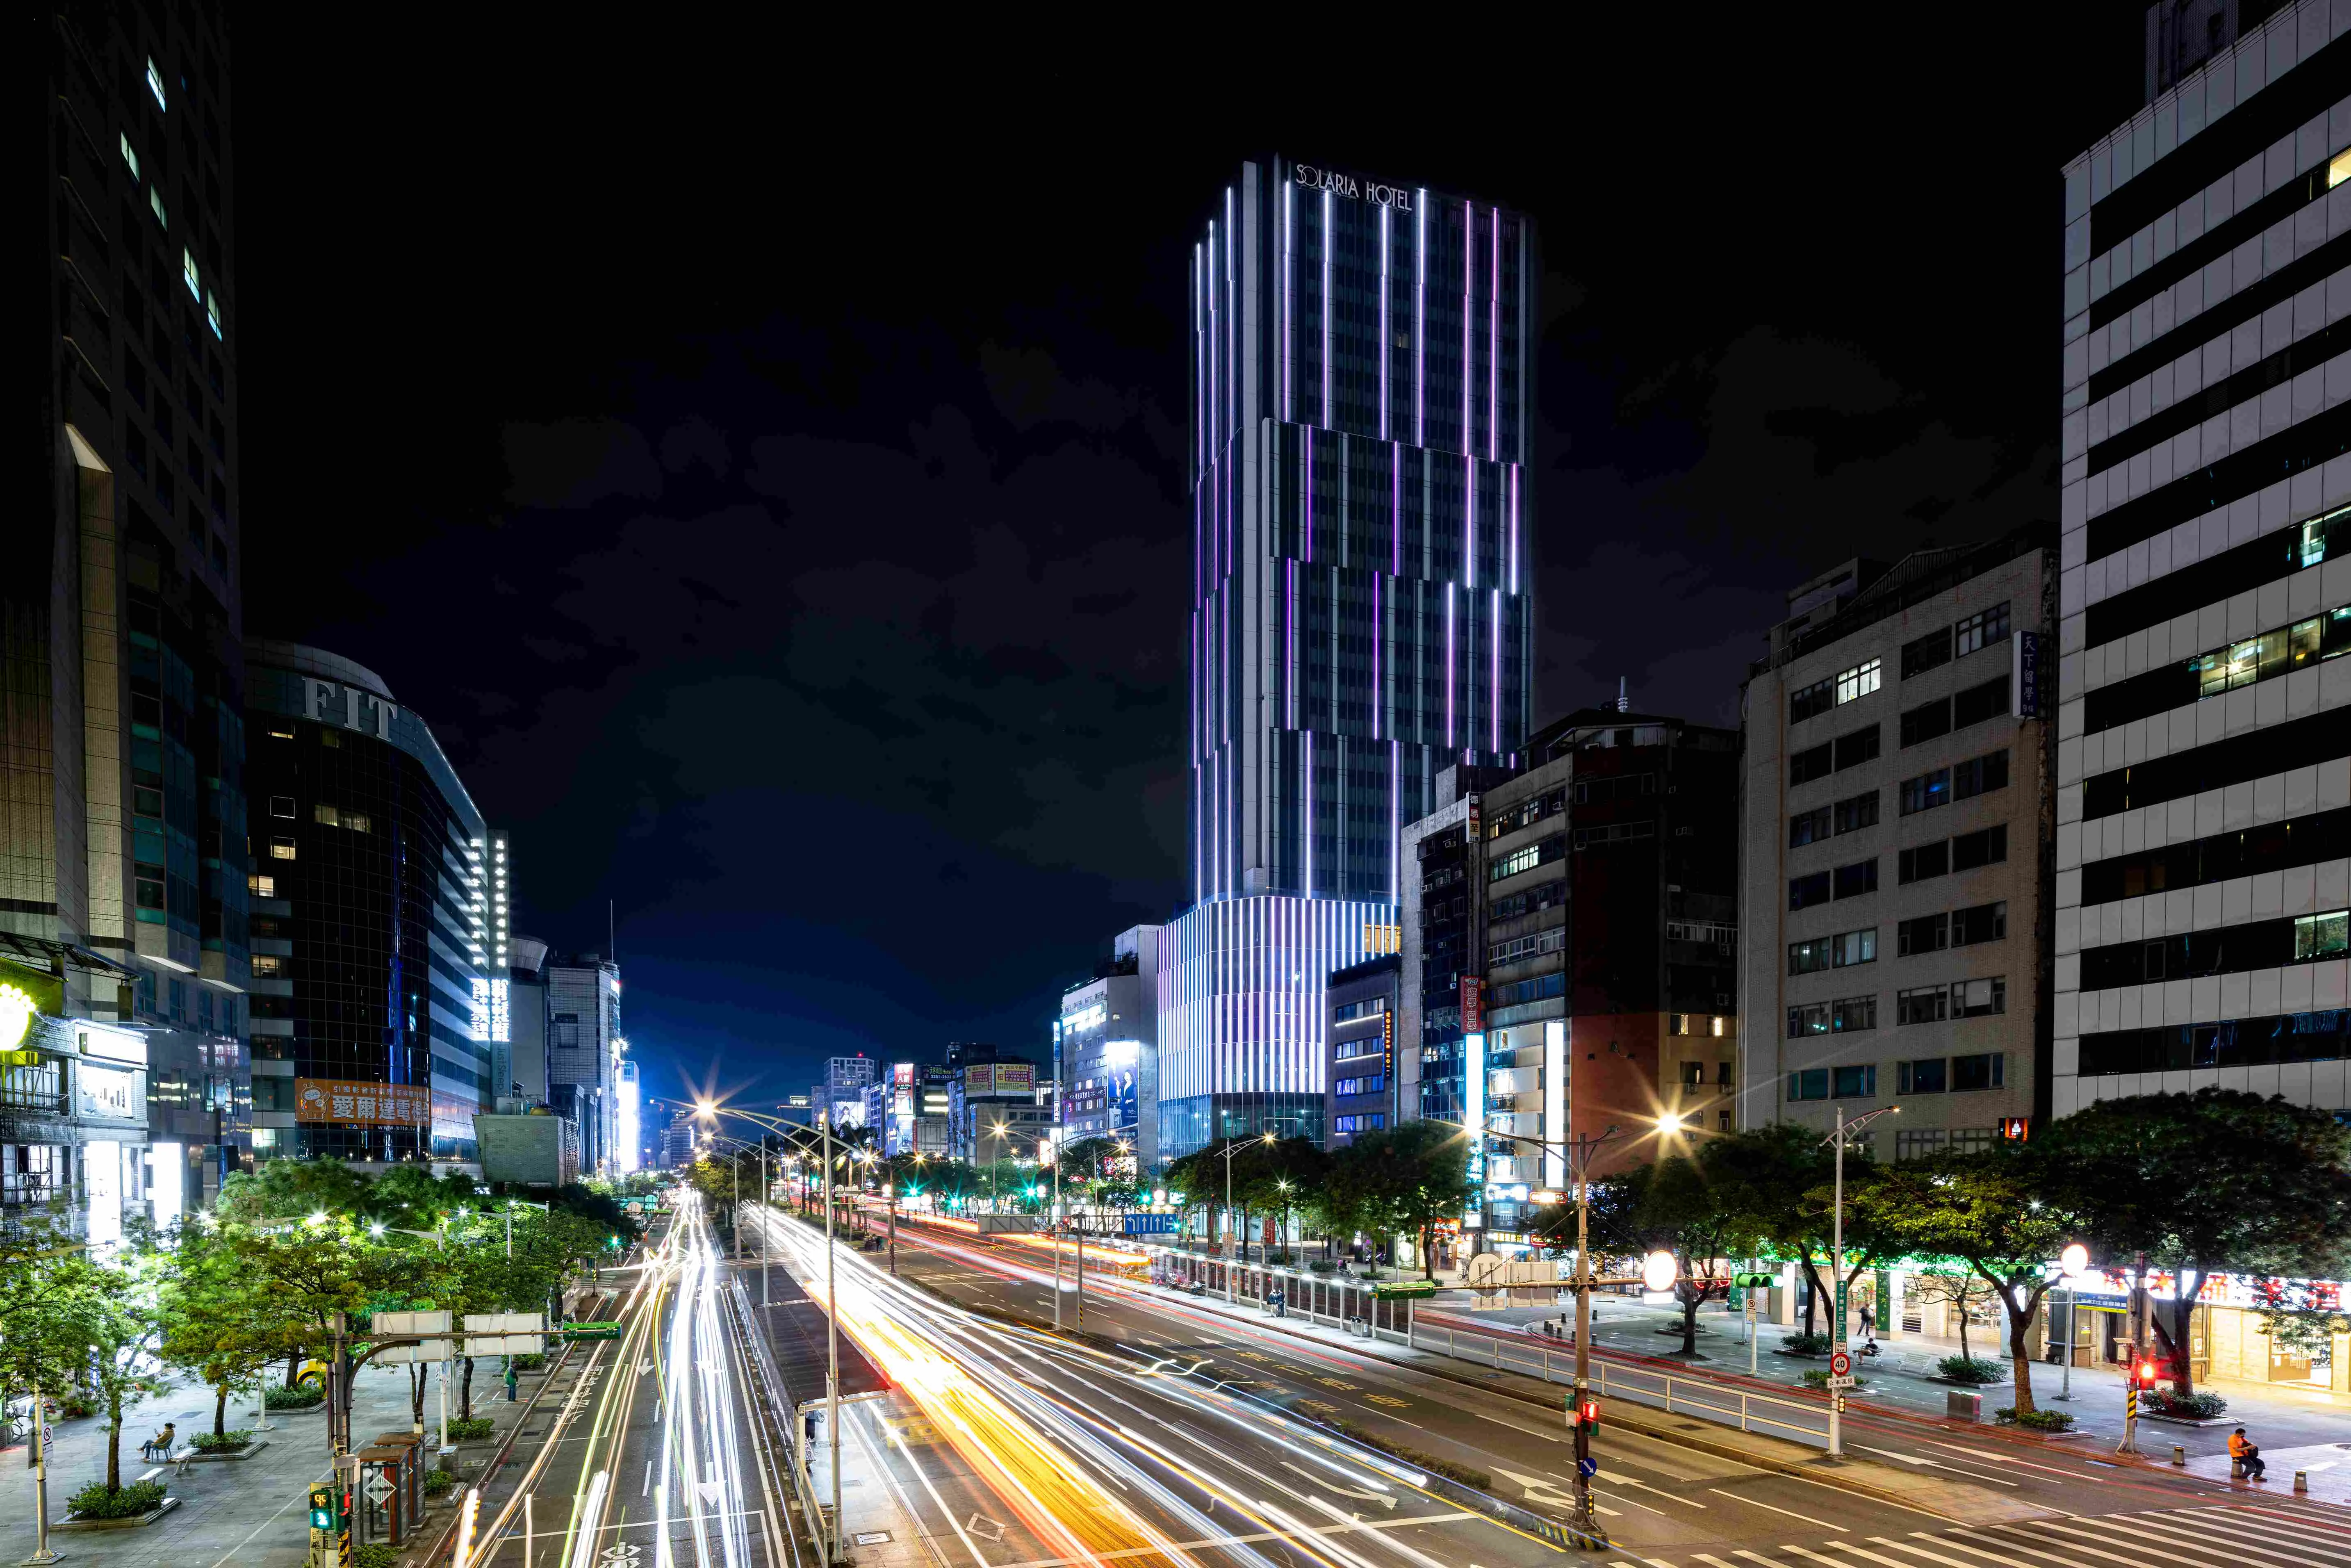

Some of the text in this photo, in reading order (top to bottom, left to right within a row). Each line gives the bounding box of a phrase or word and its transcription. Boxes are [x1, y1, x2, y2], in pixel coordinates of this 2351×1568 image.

[1296, 164, 1412, 211] SOLARIA HOTEL
[2024, 636, 2036, 700] 天下留學
[301, 676, 397, 742] FIT
